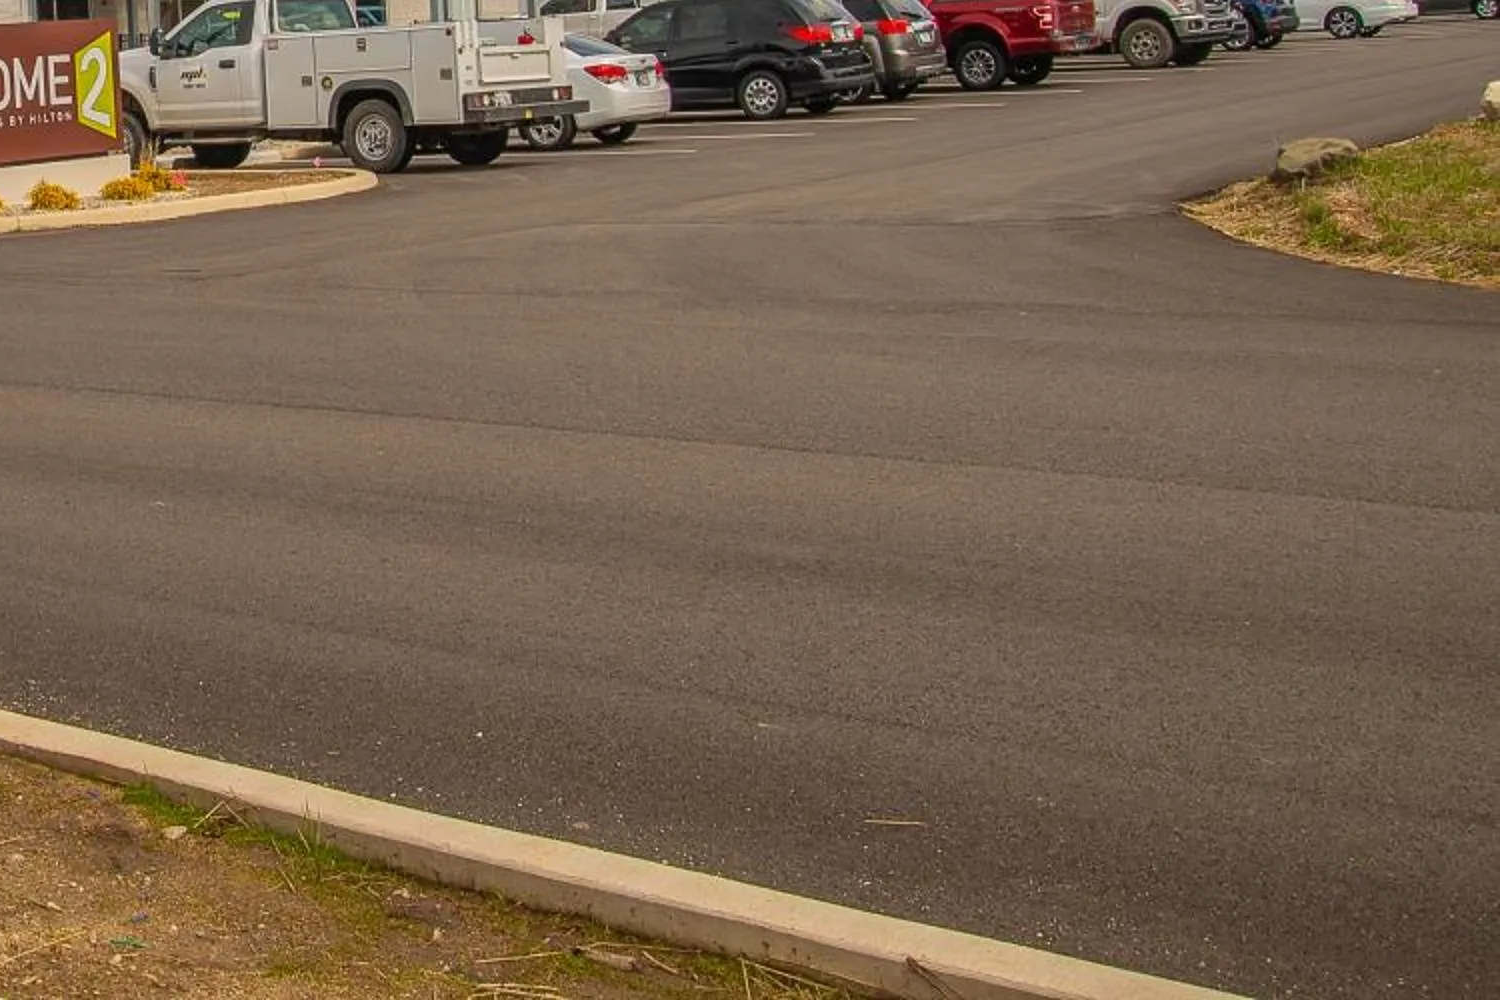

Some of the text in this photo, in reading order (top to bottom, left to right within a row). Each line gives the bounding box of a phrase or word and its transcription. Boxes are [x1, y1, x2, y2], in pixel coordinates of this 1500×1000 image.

[80, 47, 111, 127] 2
[9, 115, 25, 128] BY
[29, 111, 73, 126] HILTON
